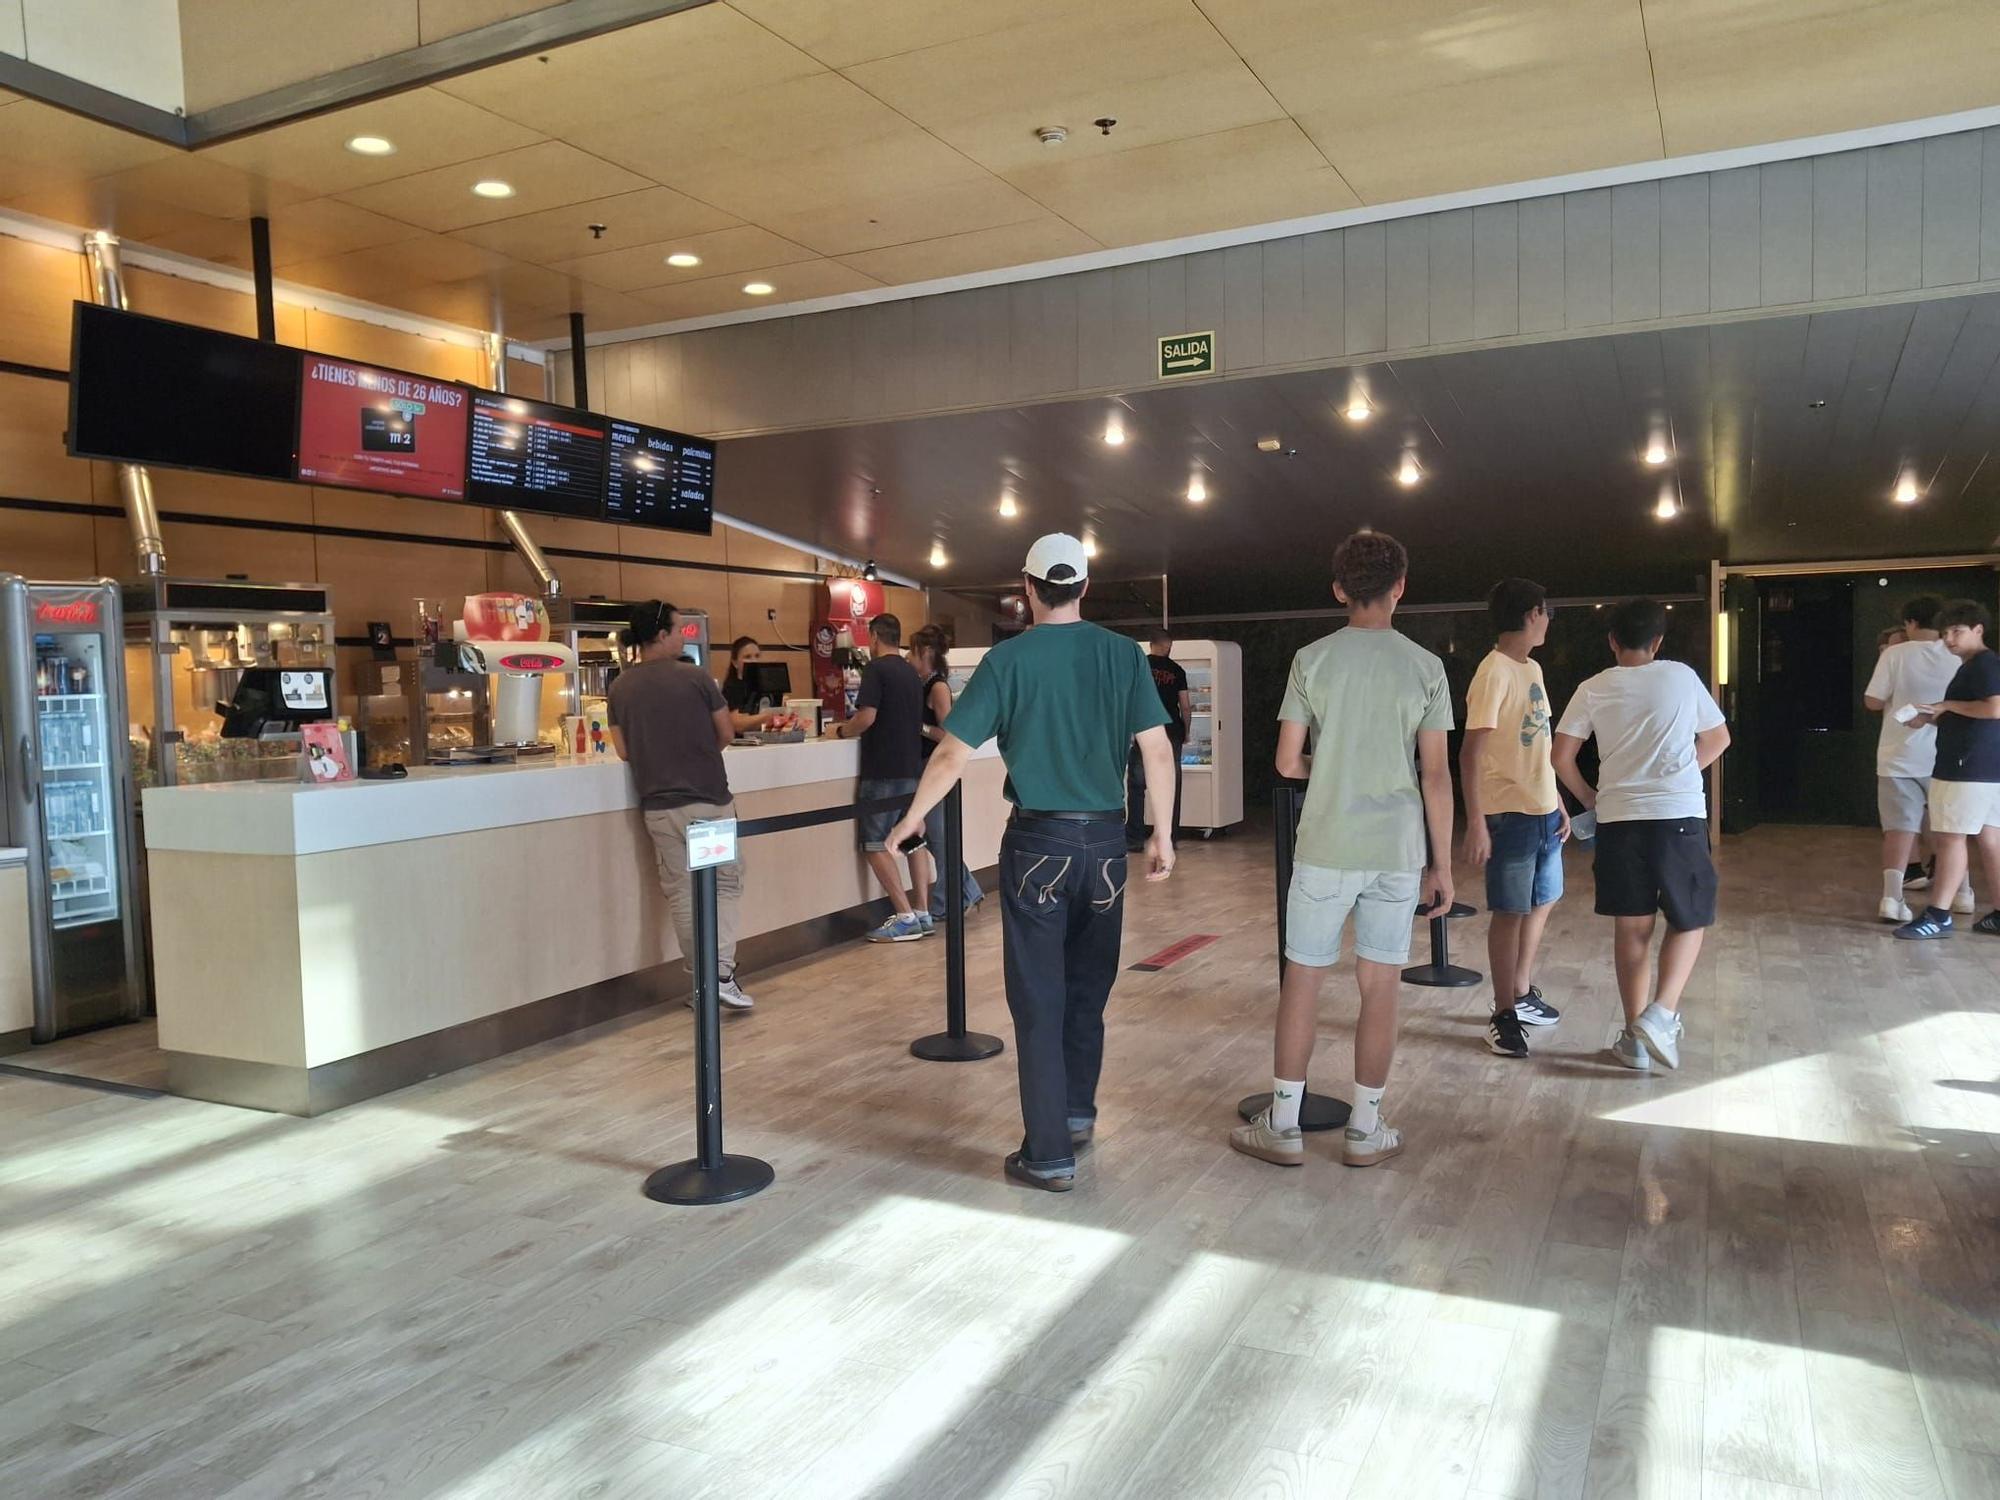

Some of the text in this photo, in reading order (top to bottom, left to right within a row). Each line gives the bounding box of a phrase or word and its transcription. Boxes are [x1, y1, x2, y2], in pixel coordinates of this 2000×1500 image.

[1164, 340, 1208, 359] SALIDA
[311, 363, 356, 387] ¿TIENES
[398, 380, 411, 398] DE
[413, 383, 427, 401] 26
[428, 385, 462, 408] AÑOS?
[612, 432, 635, 444] menús
[648, 438, 673, 452] bebidas
